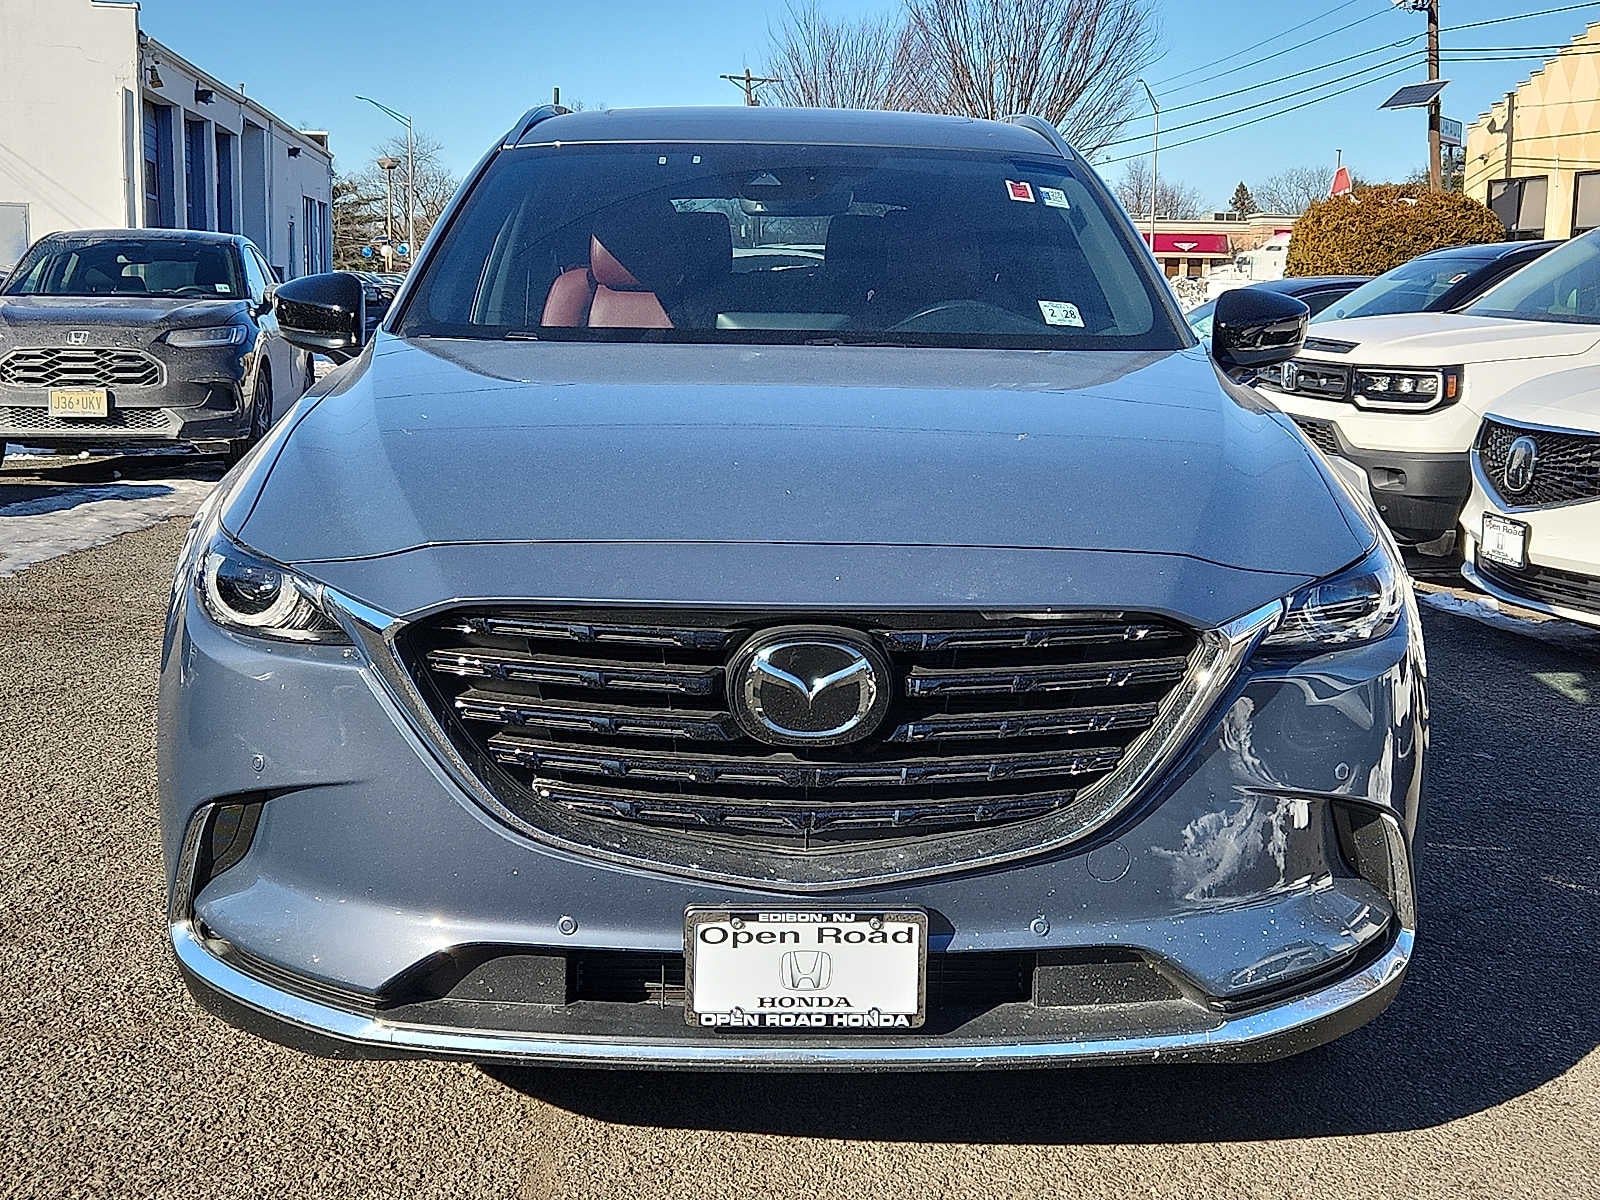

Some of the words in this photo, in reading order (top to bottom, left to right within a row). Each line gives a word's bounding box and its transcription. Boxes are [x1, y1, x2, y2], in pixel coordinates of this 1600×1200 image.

[53, 396, 75, 410] J36
[81, 396, 102, 410] UKY
[758, 913, 828, 923] EDISON,
[832, 913, 856, 923] NJ
[699, 926, 800, 949] Open
[817, 926, 914, 945] Road
[757, 996, 854, 1008] HONDA
[700, 1013, 760, 1027] OPEN
[765, 1013, 827, 1027] ROAD
[832, 1013, 910, 1028] HONDA
